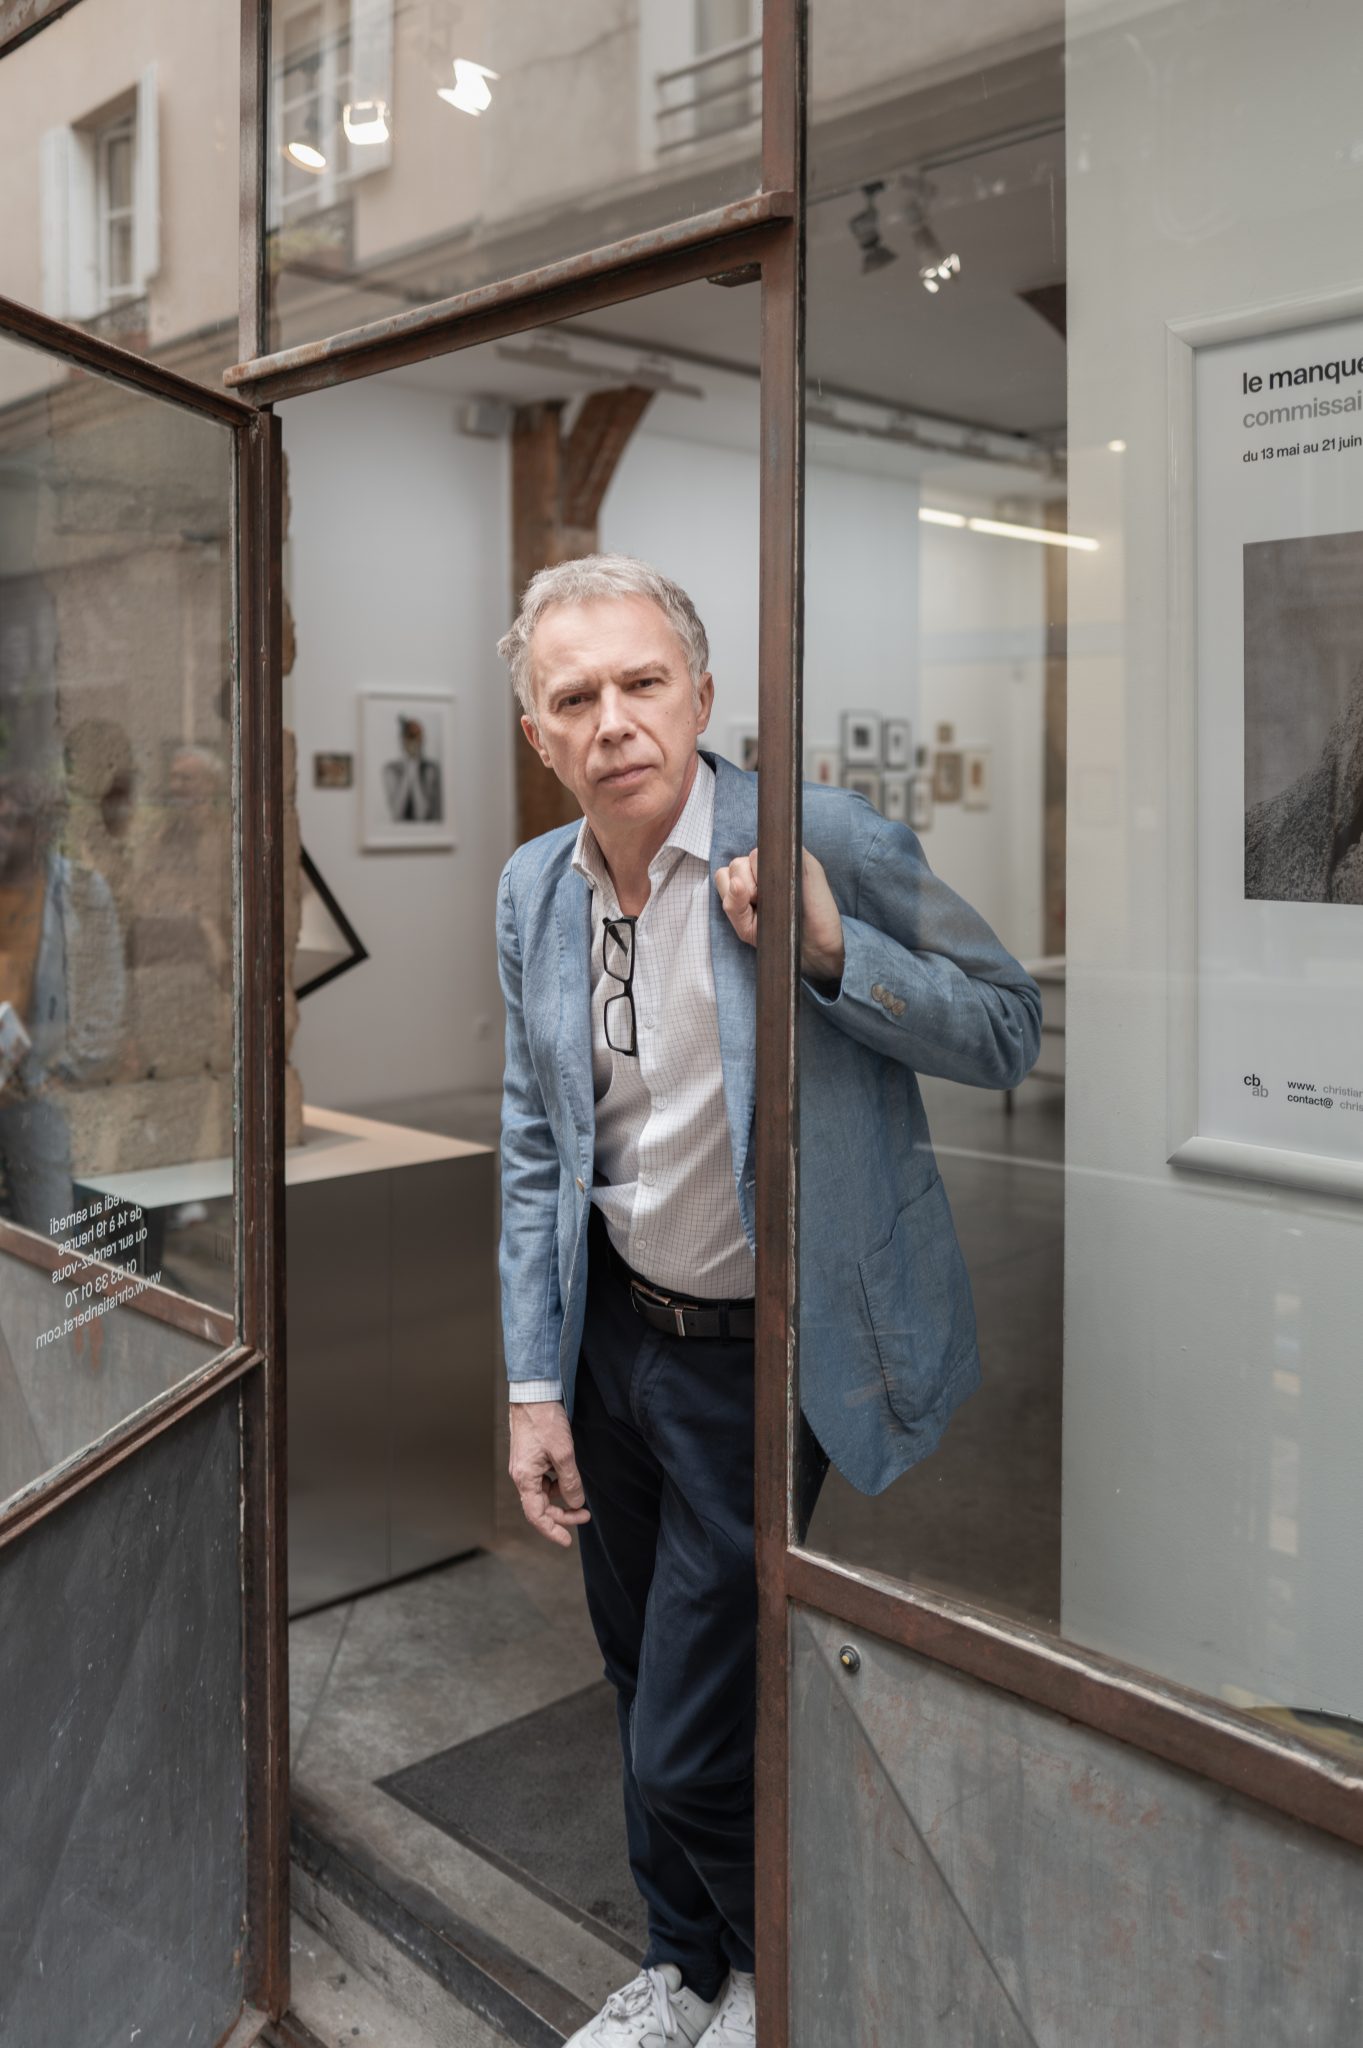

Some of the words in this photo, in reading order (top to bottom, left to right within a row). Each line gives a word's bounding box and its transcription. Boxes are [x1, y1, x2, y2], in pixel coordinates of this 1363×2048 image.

[1243, 372, 1263, 395] le
[1243, 390, 1362, 428] commissai
[1243, 450, 1258, 463] du
[1261, 447, 1274, 460] 13
[1276, 443, 1300, 458] mai
[1303, 443, 1319, 454] au
[1322, 438, 1336, 451] 21
[1338, 435, 1362, 452] juin
[1243, 1073, 1261, 1087] cb
[1287, 1081, 1317, 1092] www.
[1252, 1085, 1269, 1098] ab
[1287, 1094, 1334, 1108] contact@
